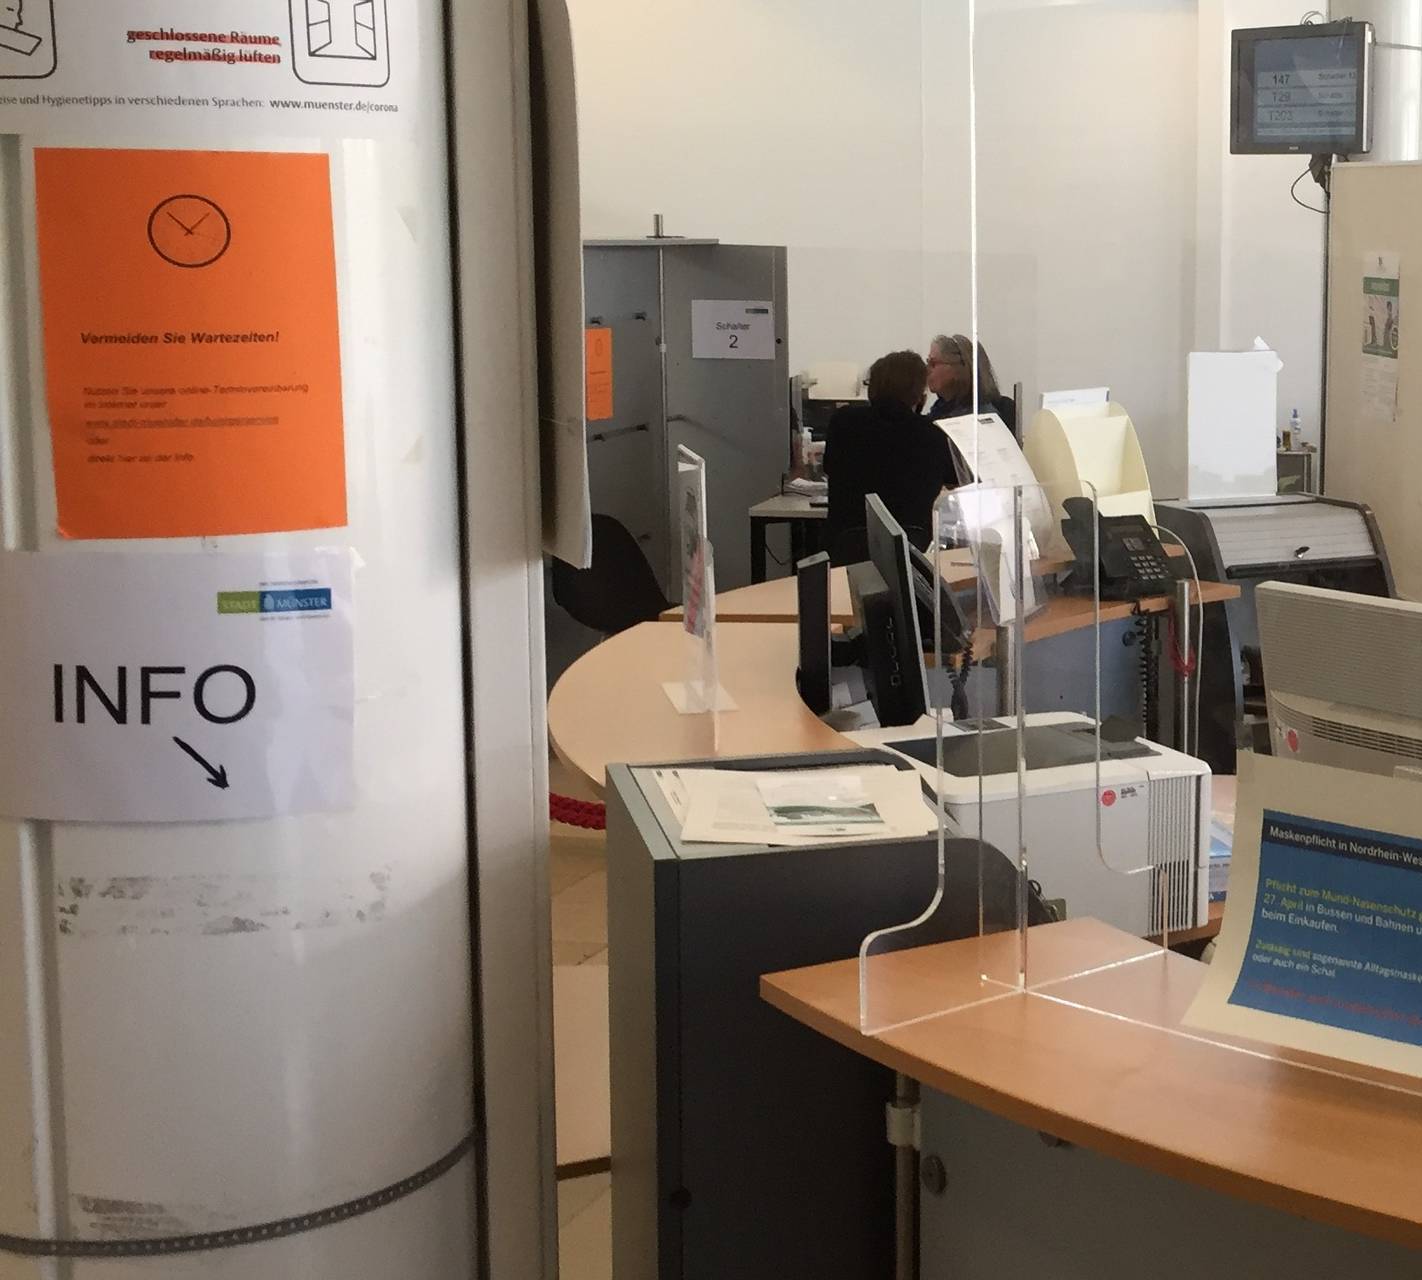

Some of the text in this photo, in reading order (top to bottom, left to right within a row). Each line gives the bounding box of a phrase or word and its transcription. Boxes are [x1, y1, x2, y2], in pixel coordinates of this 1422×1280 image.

[127, 28, 229, 43] geschlossene
[149, 48, 280, 64] regelmäßig lüften
[19, 94, 39, 105] und
[42, 94, 113, 107] Hygienetipps
[115, 95, 125, 105] in
[128, 95, 209, 106] verschiedenen
[212, 97, 264, 108] Sprachen:
[269, 99, 399, 113] www.muenster.de/corona
[80, 331, 280, 345] Vermeiden Sie Wartezeiten!
[729, 334, 739, 348] 2
[54, 664, 256, 724] INFO
[1269, 825, 1336, 849] Maskenpflicht
[1338, 842, 1348, 852] in
[1265, 878, 1296, 894] Pflicht
[1322, 889, 1416, 917] Mund-Nasenschutz
[1261, 908, 1286, 921] beim
[1280, 896, 1304, 911] April
[1305, 902, 1316, 912] in
[1317, 905, 1352, 921] Bussen
[1355, 913, 1373, 925] und
[1375, 915, 1413, 933] Bahnen
[1252, 953, 1273, 965] oder
[1273, 957, 1294, 968] auch
[1295, 962, 1310, 972] ein
[1312, 951, 1363, 971] sogenannte
